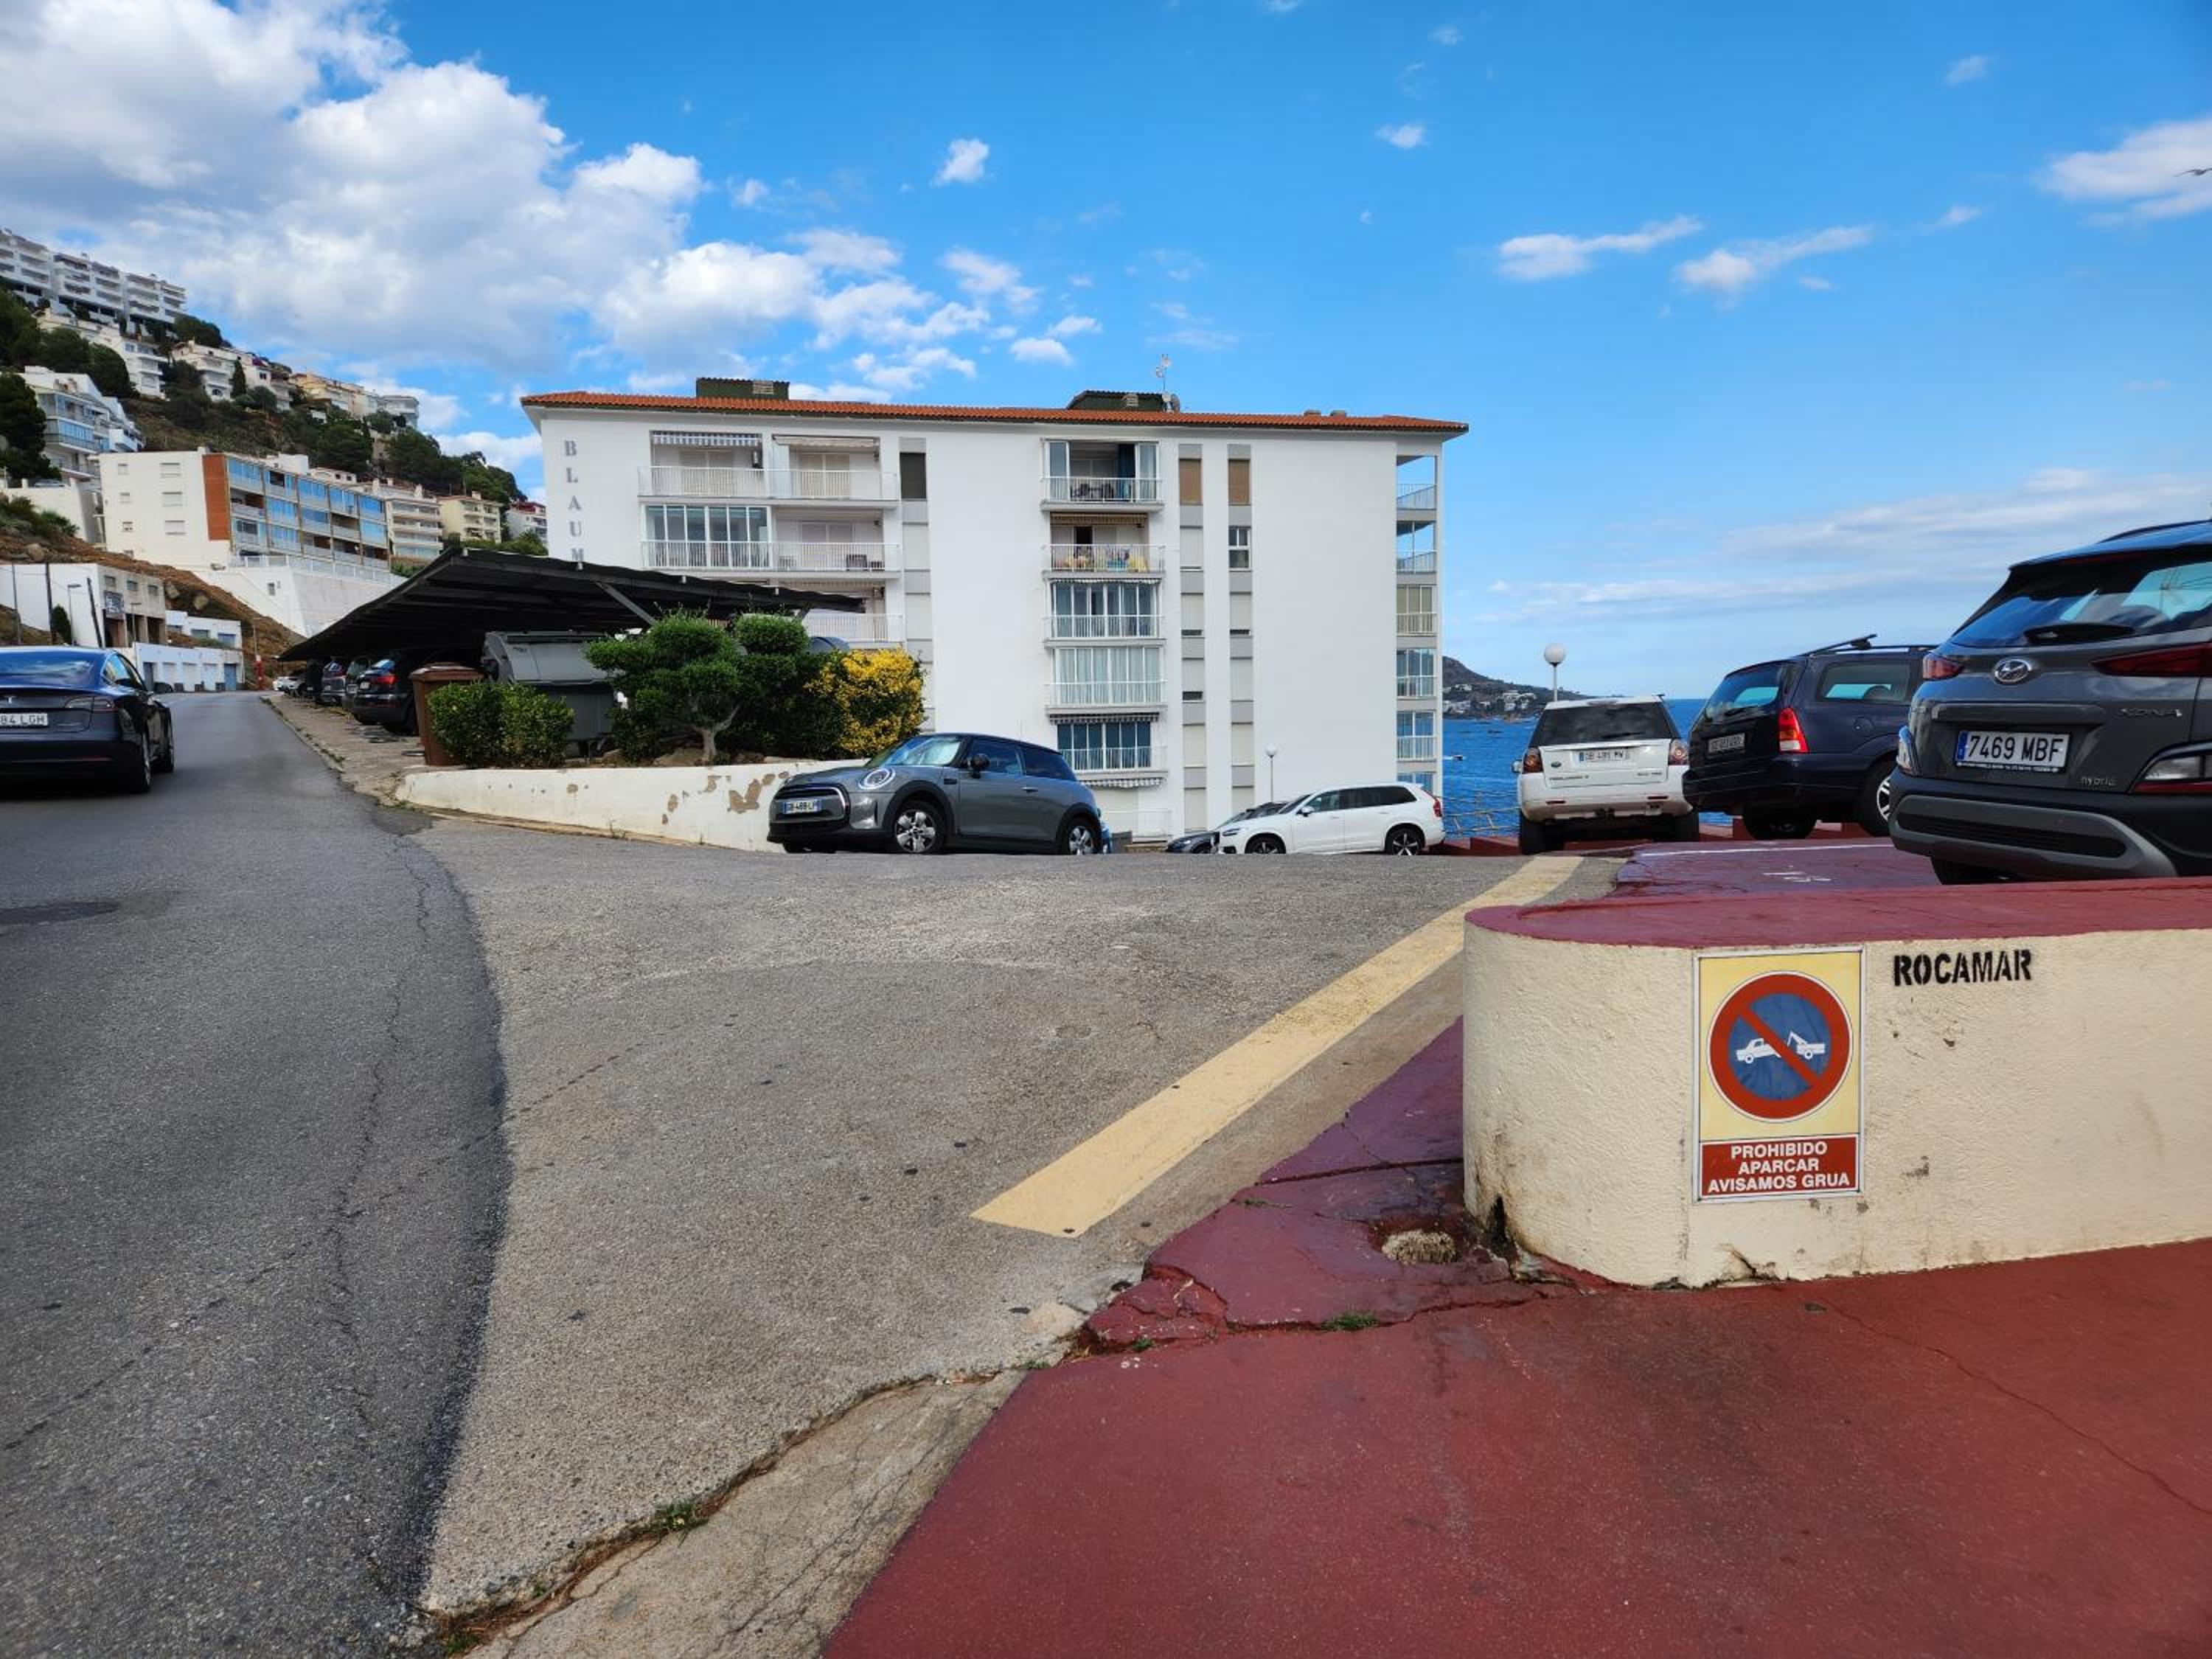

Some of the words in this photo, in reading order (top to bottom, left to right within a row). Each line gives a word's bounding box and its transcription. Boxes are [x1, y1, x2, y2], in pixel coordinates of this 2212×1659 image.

[1968, 735, 2016, 760] 7469
[2021, 737, 2064, 762] MBF
[1893, 949, 2032, 987] ROCAMAR
[1731, 1141, 1828, 1159] PROHIBIDO
[1738, 1158, 1820, 1175] APARCAR
[1708, 1175, 1797, 1193] AVISAMOS
[1801, 1172, 1850, 1188] GRUA
